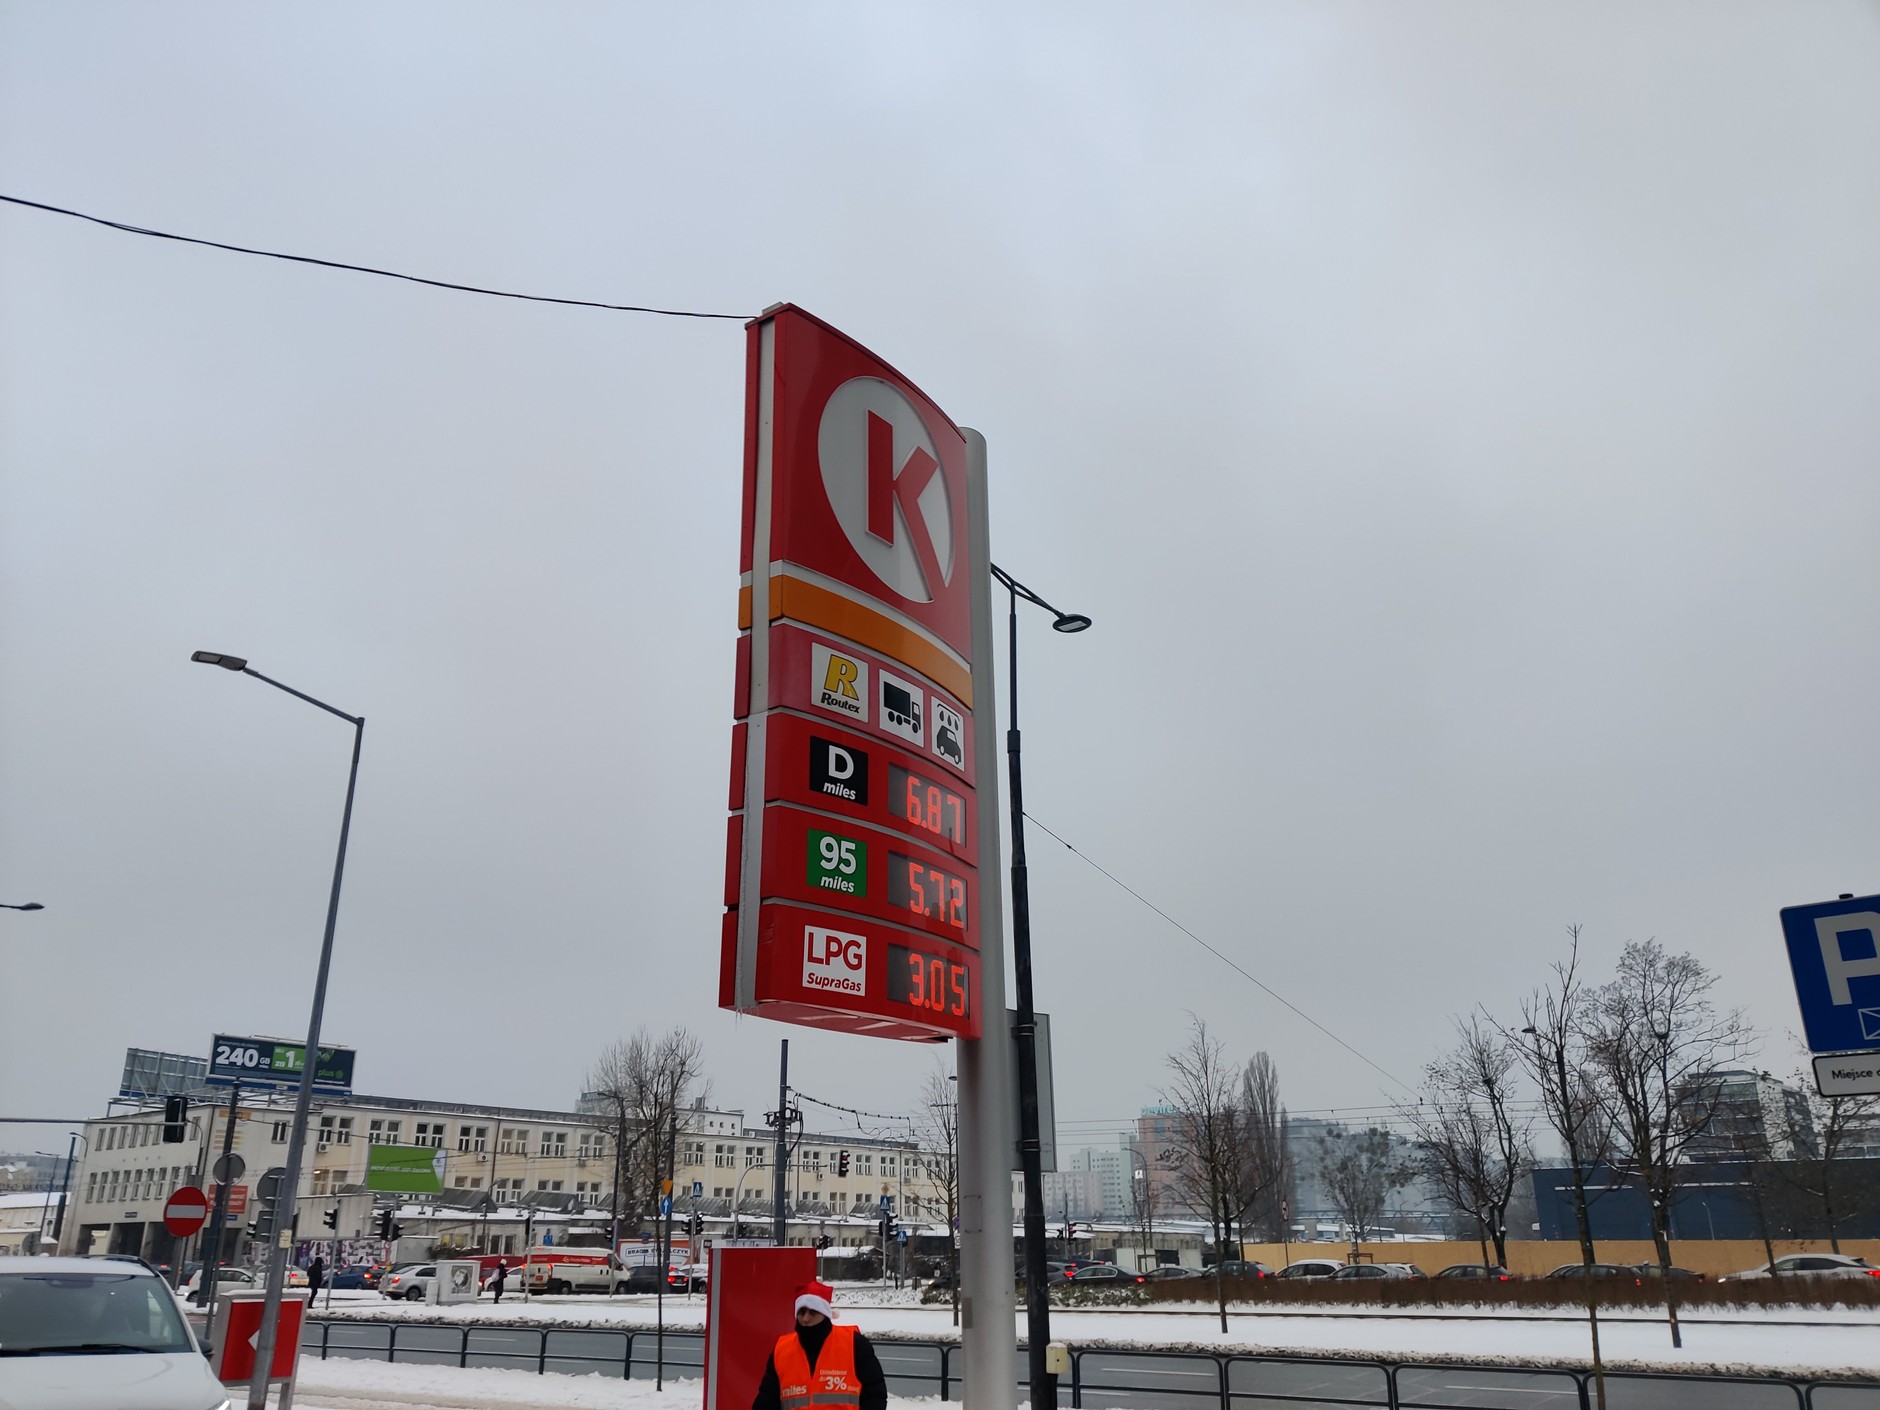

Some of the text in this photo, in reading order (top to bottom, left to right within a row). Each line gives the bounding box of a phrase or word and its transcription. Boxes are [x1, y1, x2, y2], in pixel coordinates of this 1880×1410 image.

[866, 409, 948, 602] K
[824, 653, 859, 701] R
[820, 692, 860, 713] Routex
[828, 744, 854, 780] D
[823, 781, 856, 801] miles
[905, 775, 962, 844] 6.87
[819, 835, 856, 874] 95
[820, 873, 855, 893] miles
[908, 861, 965, 929] 5.72
[806, 931, 863, 971] LPG
[1814, 911, 1880, 1006] P
[806, 972, 862, 992] SupraGas
[908, 953, 965, 1017] 3.05
[215, 1046, 271, 1068] 240 GB
[285, 1050, 296, 1069] 1
[1831, 1068, 1873, 1081] Miejsce
[782, 1385, 807, 1397] miles
[825, 1376, 847, 1391] 3%
